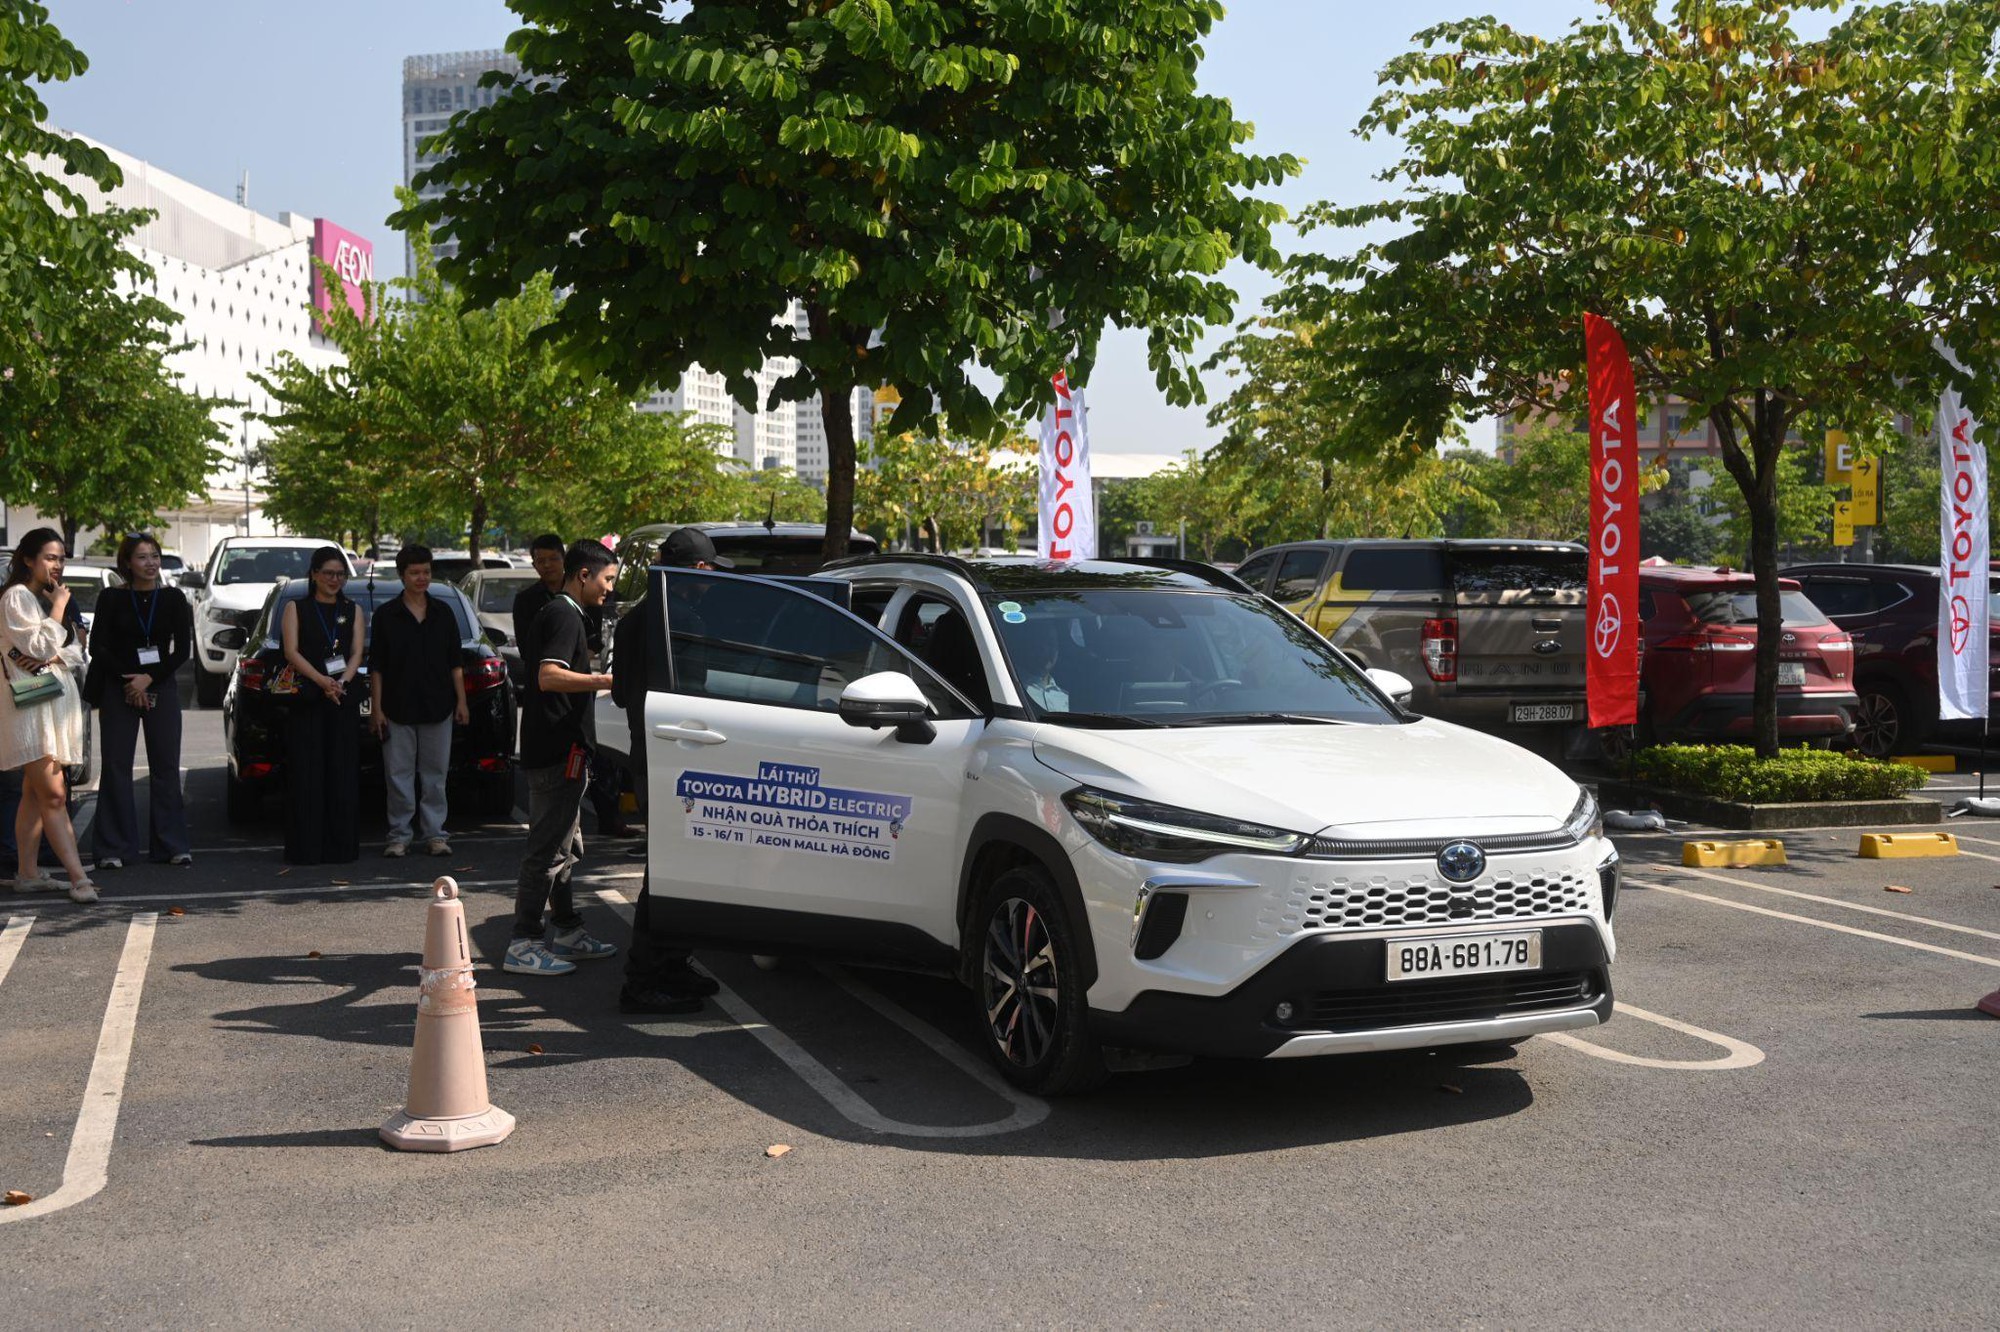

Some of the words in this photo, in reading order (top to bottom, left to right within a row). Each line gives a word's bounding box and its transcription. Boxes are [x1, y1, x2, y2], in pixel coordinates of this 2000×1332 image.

[1049, 368, 1074, 560] TOYOTA
[1599, 399, 1622, 585] TOYOTA
[1949, 418, 1973, 588] TOYOTA
[760, 767, 783, 781] LÁI
[787, 769, 818, 785] THỬ
[683, 780, 743, 799] TOYOTA
[747, 782, 826, 809] HYBRID
[828, 797, 902, 817] ELECTRIC
[693, 827, 704, 836] 15
[734, 832, 744, 841] 11
[703, 806, 747, 824] NHẬN
[750, 811, 783, 827] QUÀ
[787, 815, 829, 833] THỎA
[833, 821, 879, 839] THÍCH
[756, 836, 791, 848] AEON
[794, 840, 828, 852] MALL
[831, 844, 849, 855] HÀ
[853, 846, 890, 860] ĐÔNG
[1401, 939, 1528, 973] 88A-681.78
